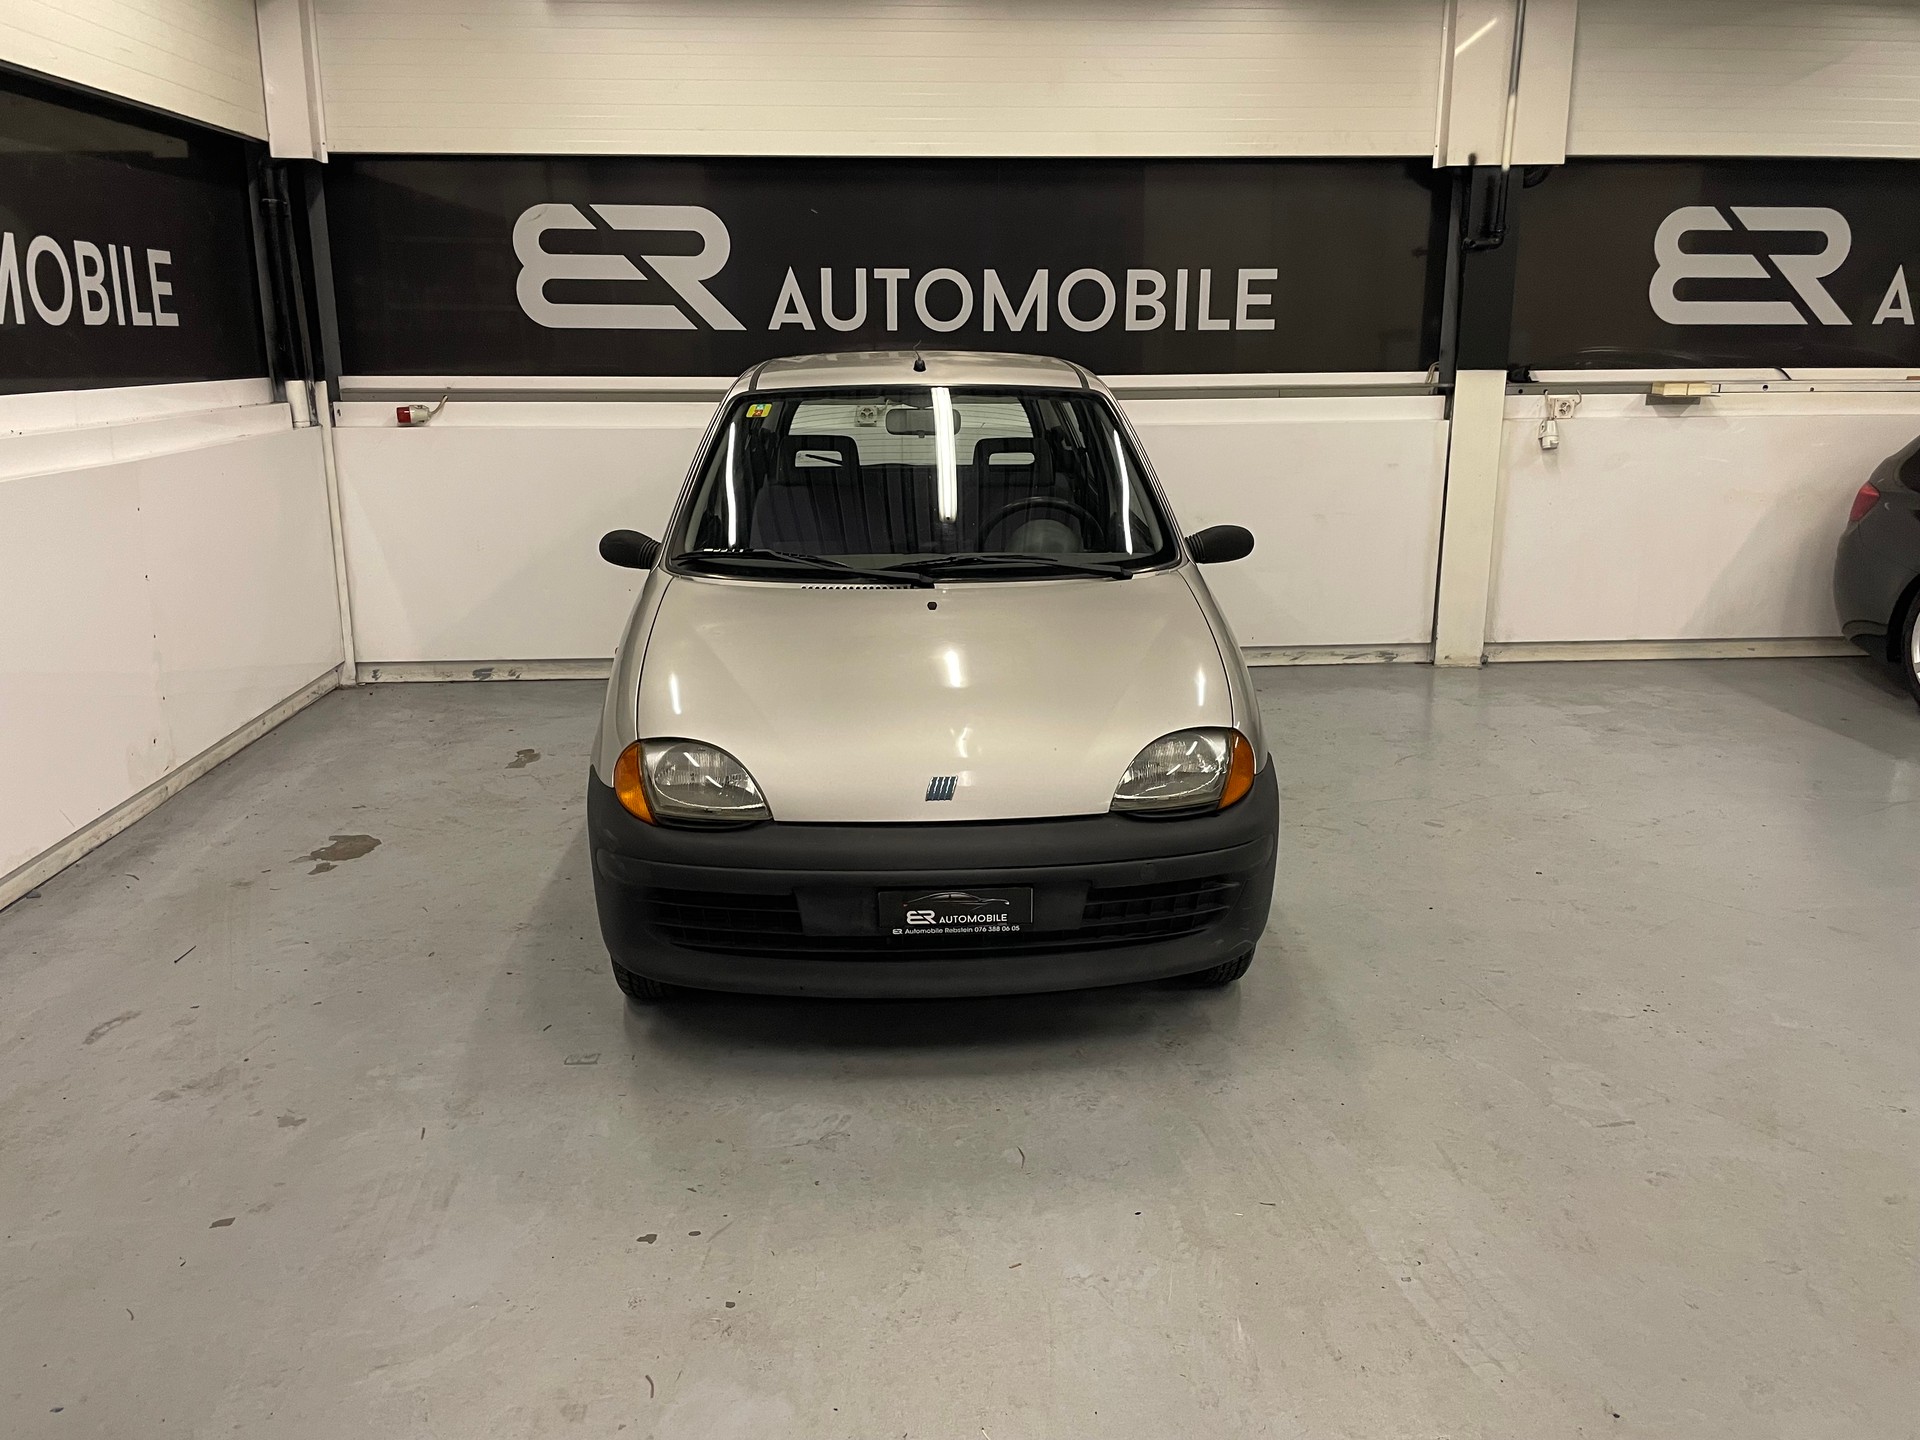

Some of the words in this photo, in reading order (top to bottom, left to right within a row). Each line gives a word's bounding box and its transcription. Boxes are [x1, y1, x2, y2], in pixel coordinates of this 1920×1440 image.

[767, 266, 1279, 333] AUTOMOBILE
[1871, 264, 1915, 326] A
[904, 927, 944, 935] Automobile
[944, 926, 974, 934] Rebstein
[1011, 924, 1020, 932] 05
[938, 913, 1008, 924] AUTOMOBILE
